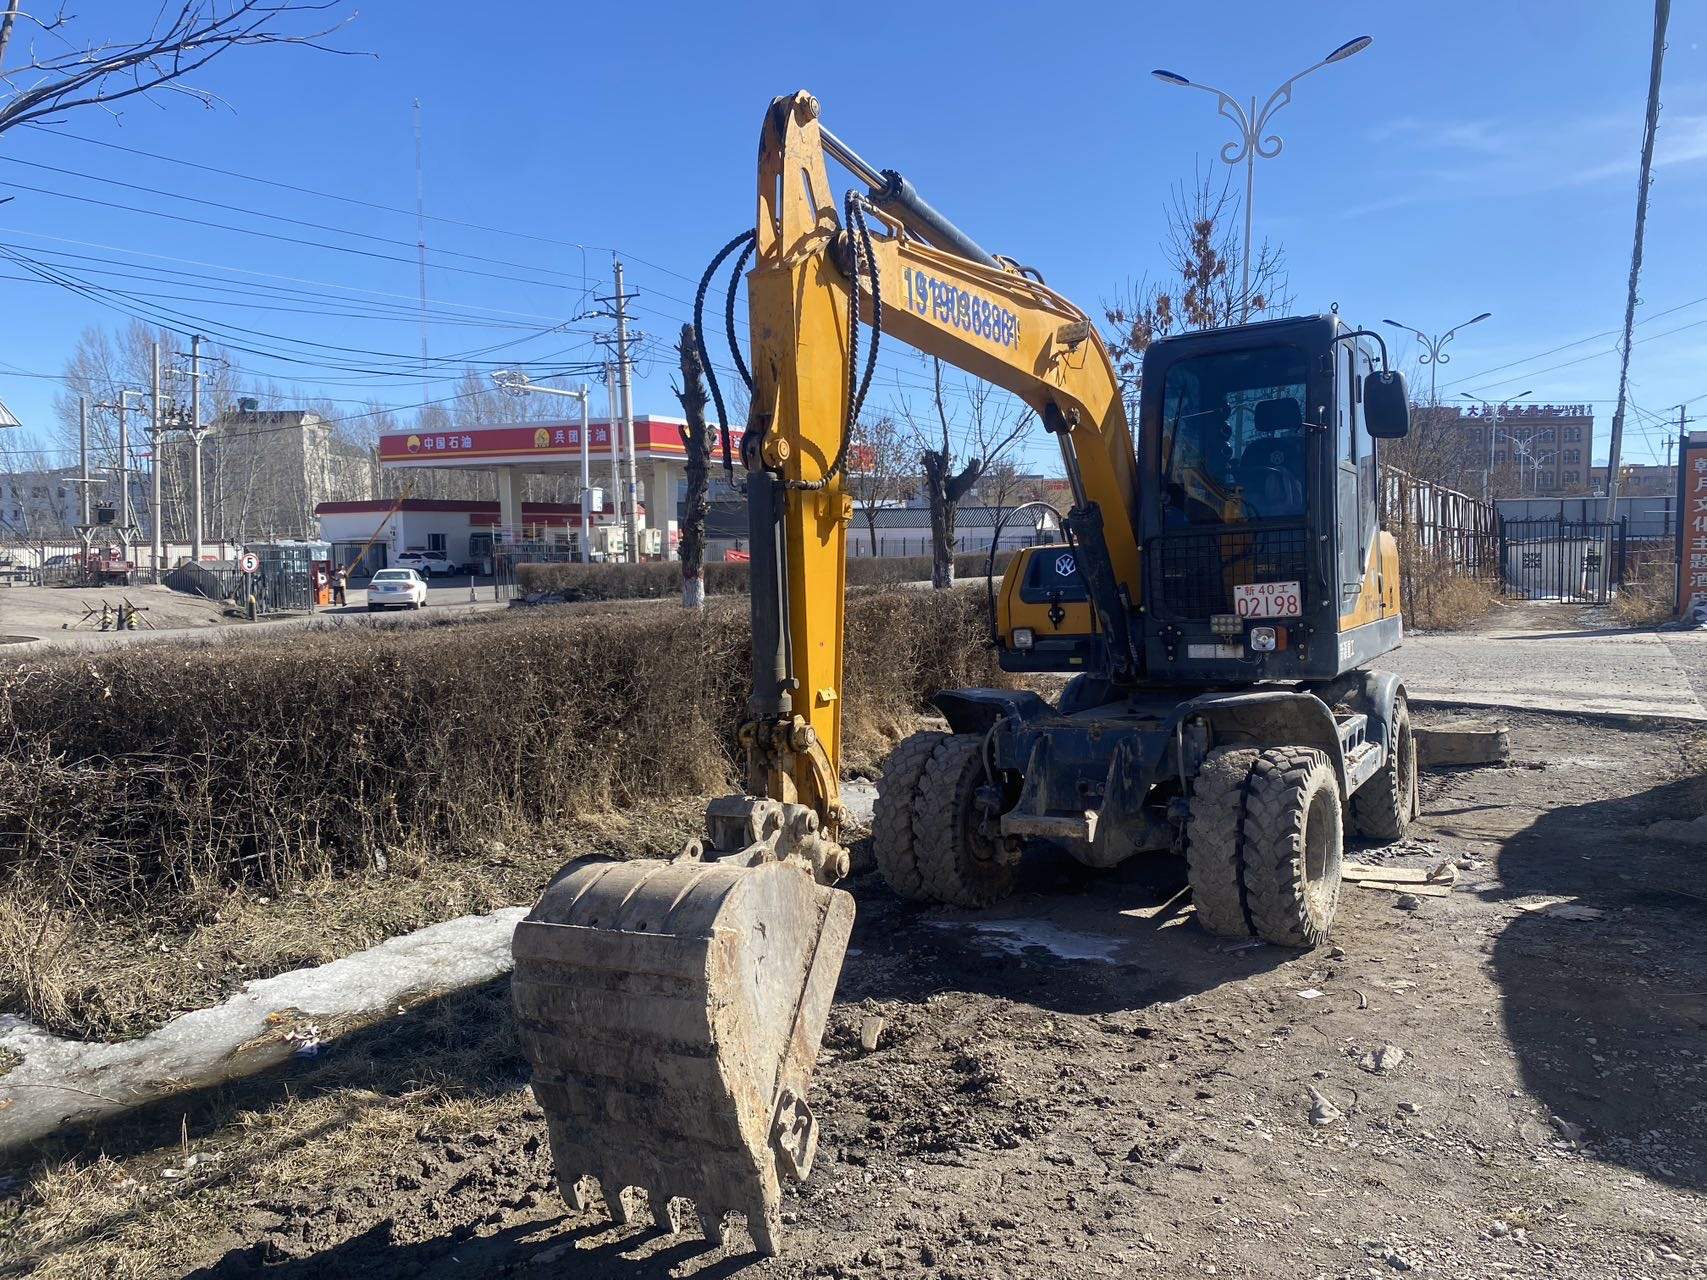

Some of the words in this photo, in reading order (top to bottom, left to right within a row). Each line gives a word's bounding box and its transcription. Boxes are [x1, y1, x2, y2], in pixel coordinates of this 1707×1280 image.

[424, 435, 472, 450] 中国石油
[247, 557, 253, 569] 5
[1237, 595, 1298, 617] 02198
